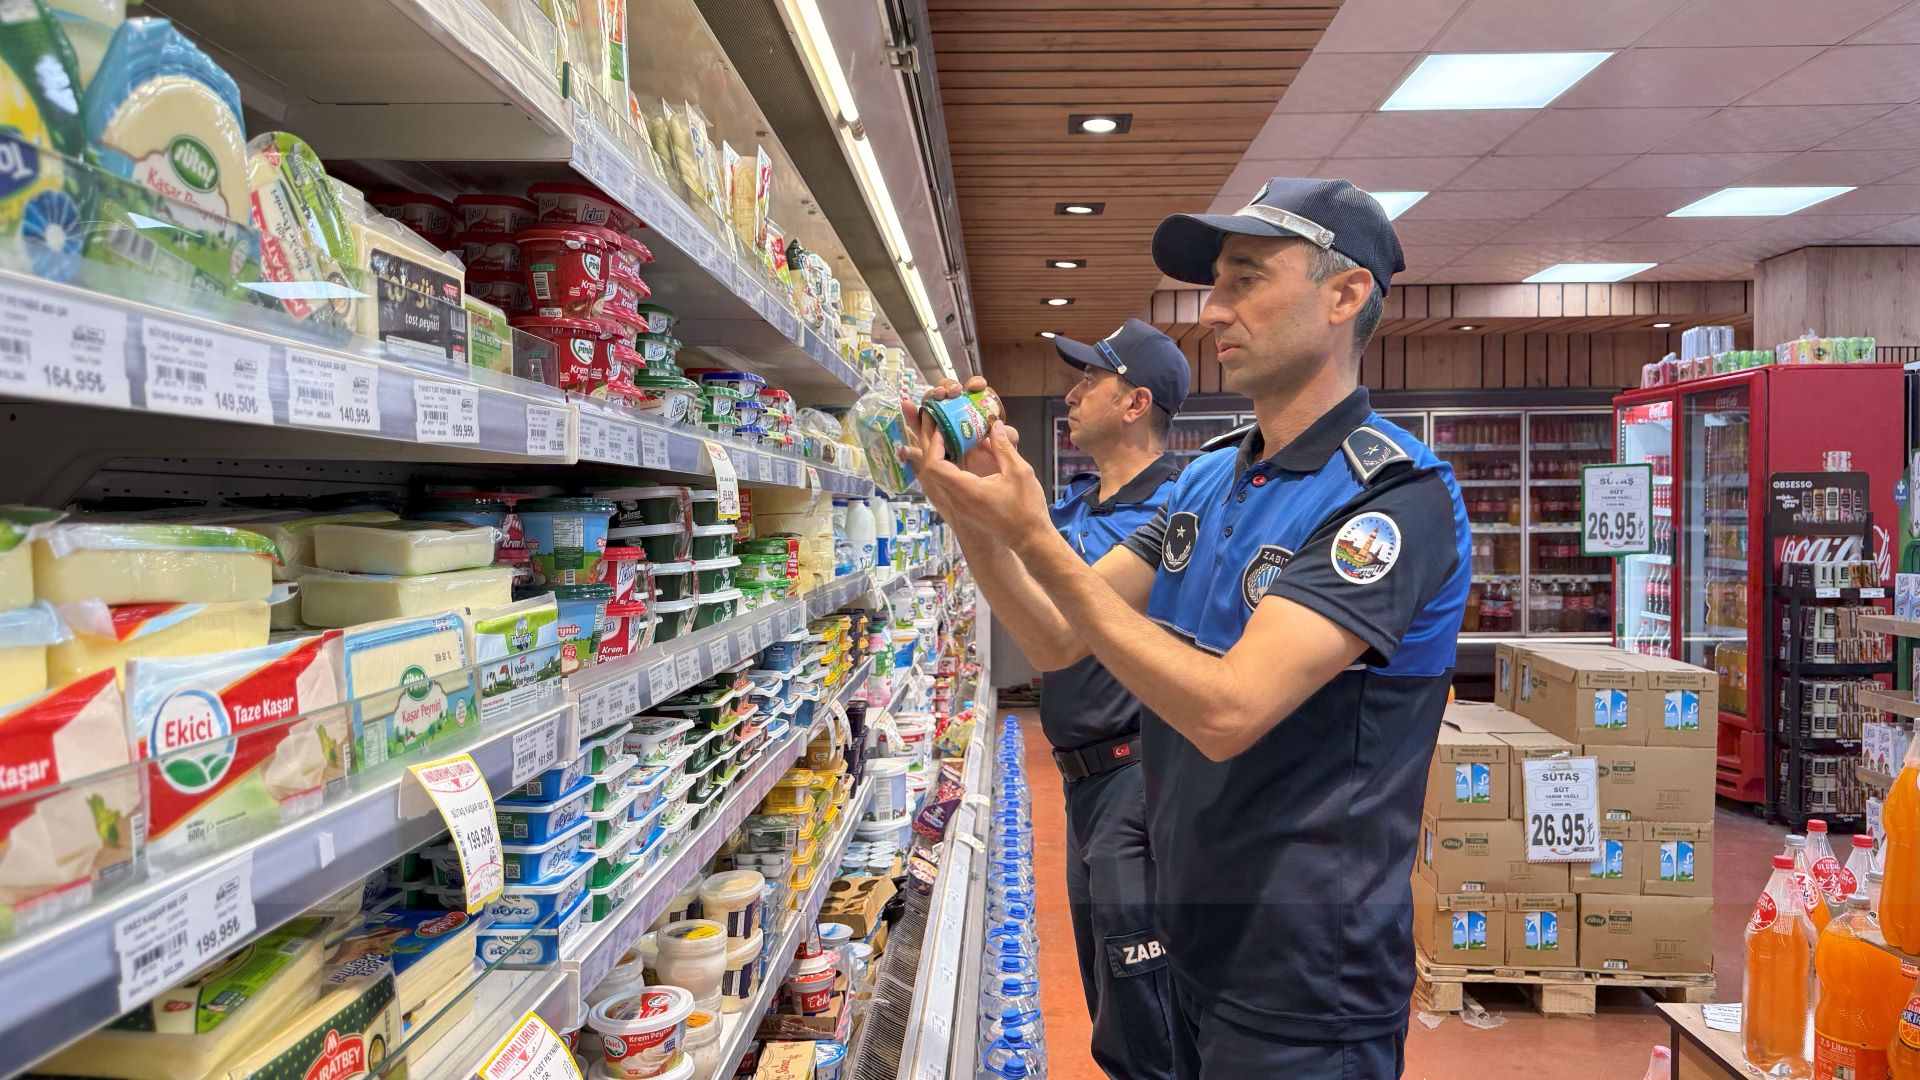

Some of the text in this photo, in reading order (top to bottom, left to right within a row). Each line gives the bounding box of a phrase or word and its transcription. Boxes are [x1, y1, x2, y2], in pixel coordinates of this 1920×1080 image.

[214, 391, 258, 415] 149,50₺
[340, 406, 371, 425] 140,95₺
[1773, 481, 1812, 489] OBSESSO
[233, 695, 295, 725] Taze Kaşar
[401, 698, 441, 723] Kaşar Peyniri
[164, 713, 213, 748] Ekici
[1542, 771, 1580, 784] SÜTAŞ
[196, 916, 241, 957] 199,95₺
[629, 1034, 650, 1043] Krem
[1831, 1043, 1848, 1053] Litre
[313, 1046, 361, 1080] URATBEY
[533, 1063, 547, 1078] TOST
